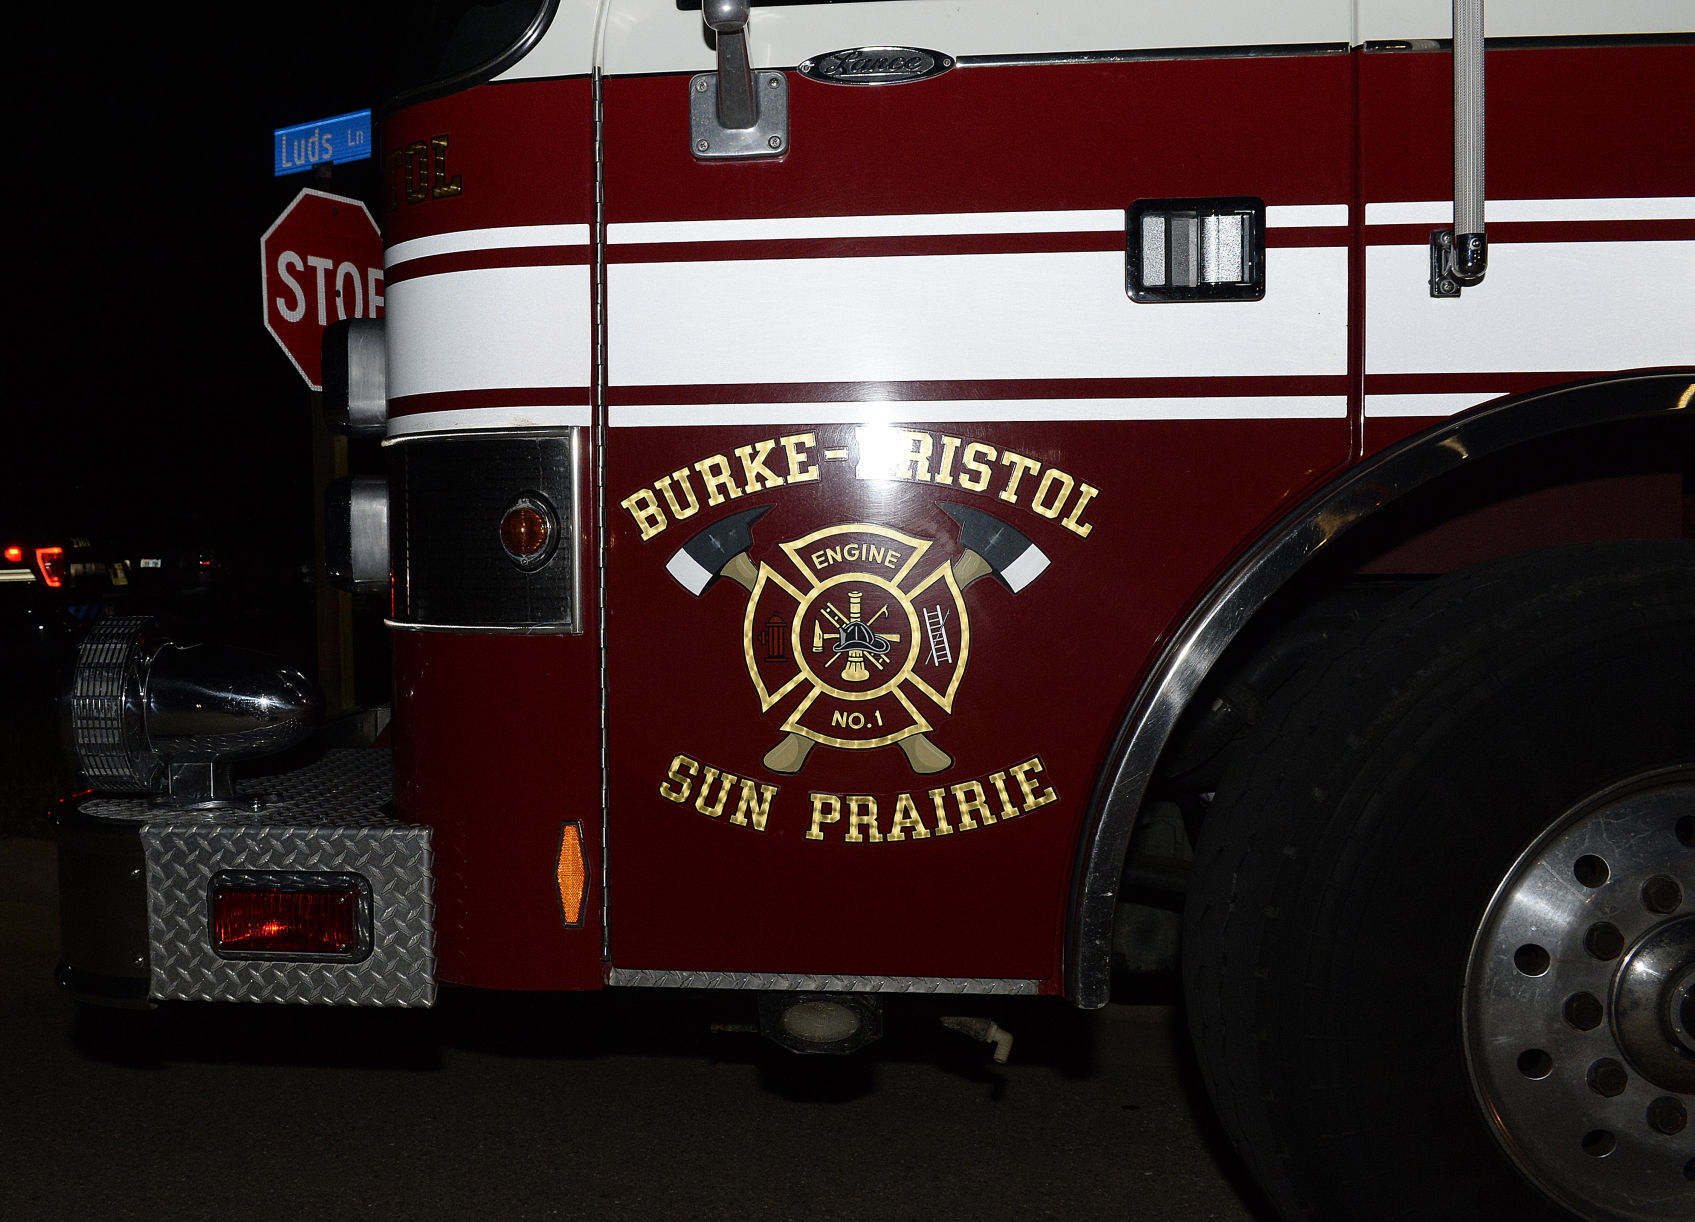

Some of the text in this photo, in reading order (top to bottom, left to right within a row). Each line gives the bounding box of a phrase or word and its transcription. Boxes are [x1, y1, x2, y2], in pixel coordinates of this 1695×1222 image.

[824, 51, 922, 74] Lance
[281, 128, 364, 168] Luds Ln
[811, 543, 901, 570] ENGINE
[831, 710, 883, 730] NO.1
[660, 754, 1058, 842] SUN PRAIRIE
